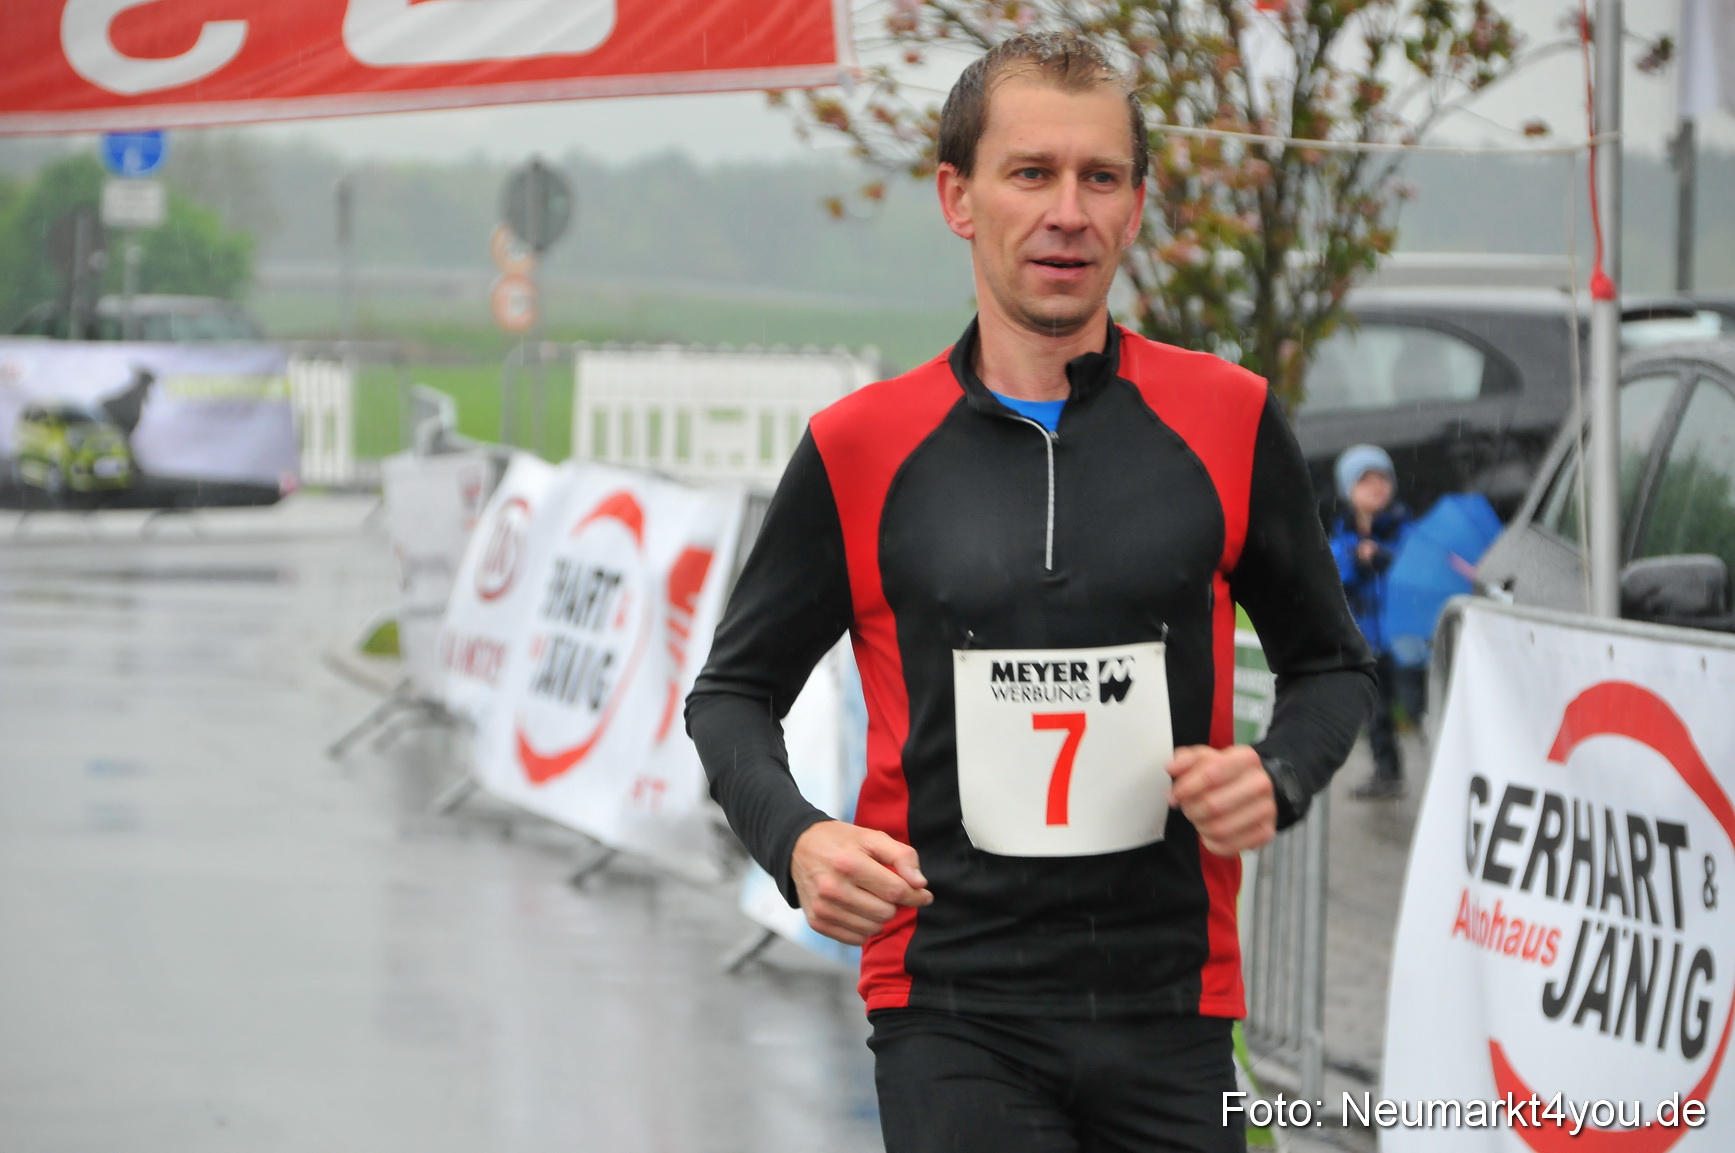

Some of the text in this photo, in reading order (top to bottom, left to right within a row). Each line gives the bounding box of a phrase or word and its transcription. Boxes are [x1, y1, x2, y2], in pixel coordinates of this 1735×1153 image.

[990, 660, 1091, 683] MEYER
[990, 684, 1092, 703] WERBUNG
[1031, 711, 1087, 827] 7
[1465, 774, 1718, 932] GERHART &
[1541, 918, 1716, 1060] JÄNIG
